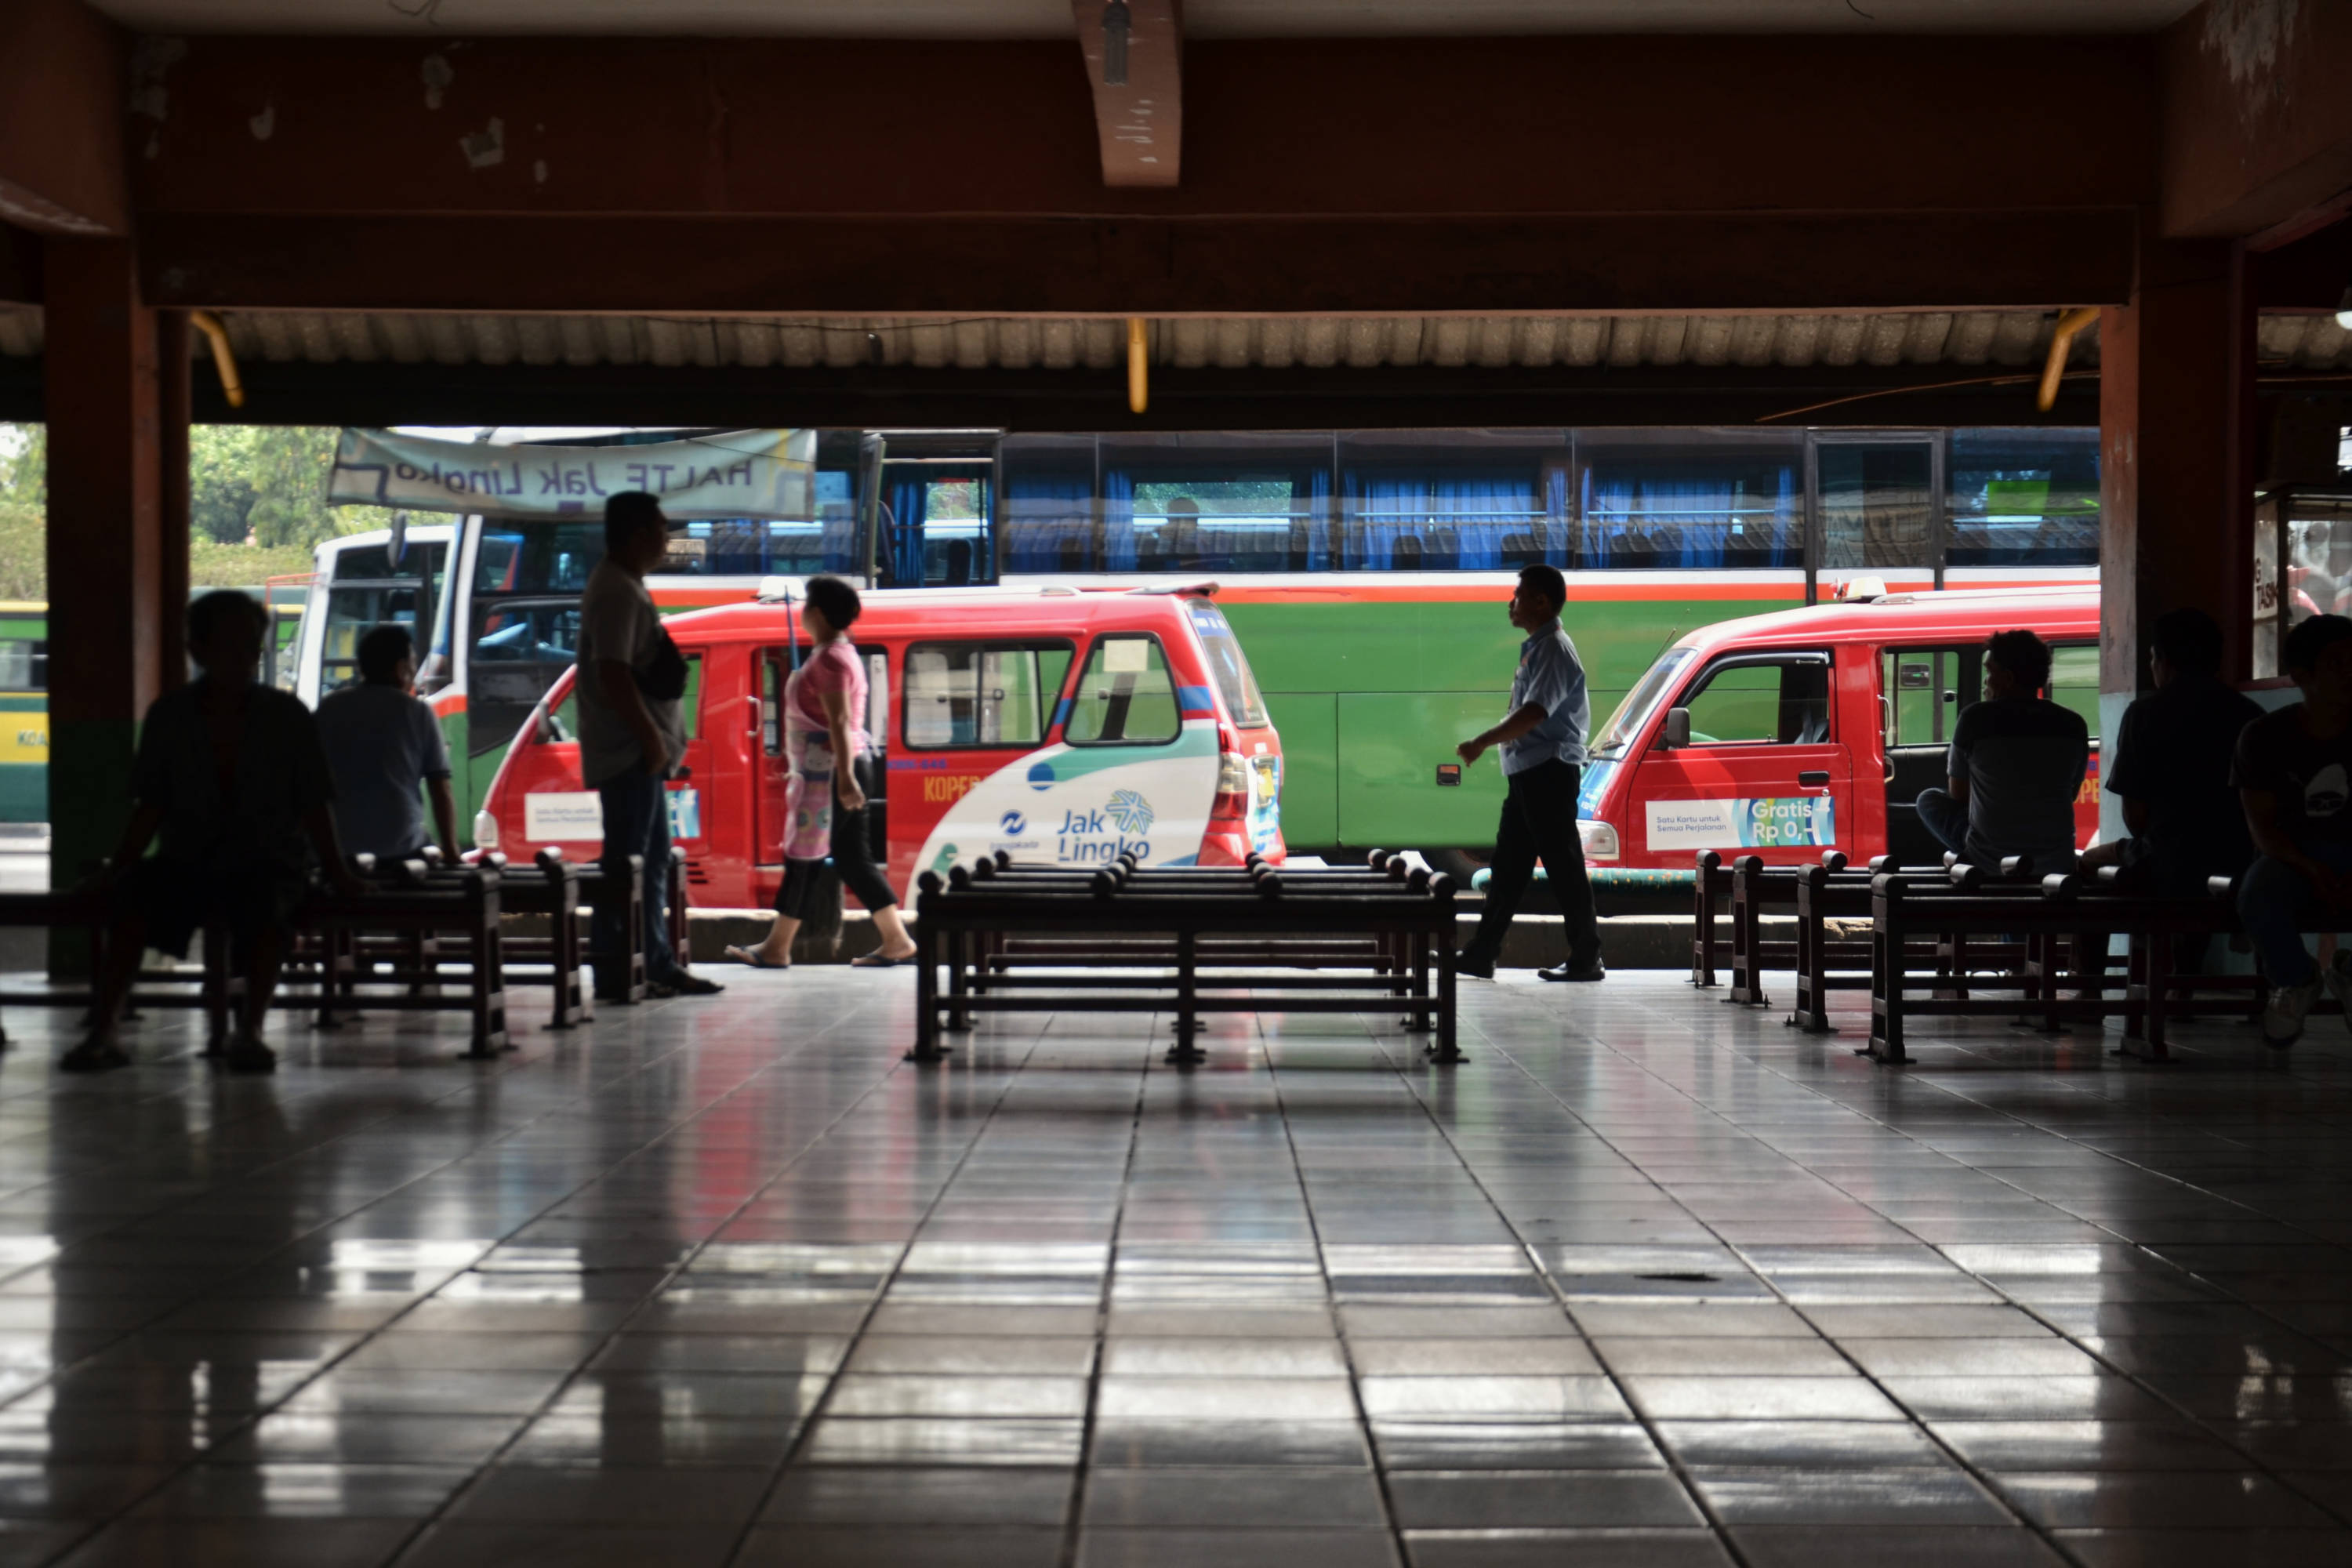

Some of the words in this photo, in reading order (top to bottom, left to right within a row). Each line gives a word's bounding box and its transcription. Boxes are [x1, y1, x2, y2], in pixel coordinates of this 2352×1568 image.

[1751, 800, 1813, 818] Gratis
[1057, 808, 1105, 835] Jak
[1685, 823, 1726, 832] Perjalanan
[1752, 822, 1779, 843] Rp
[1058, 835, 1150, 866] Lingko
